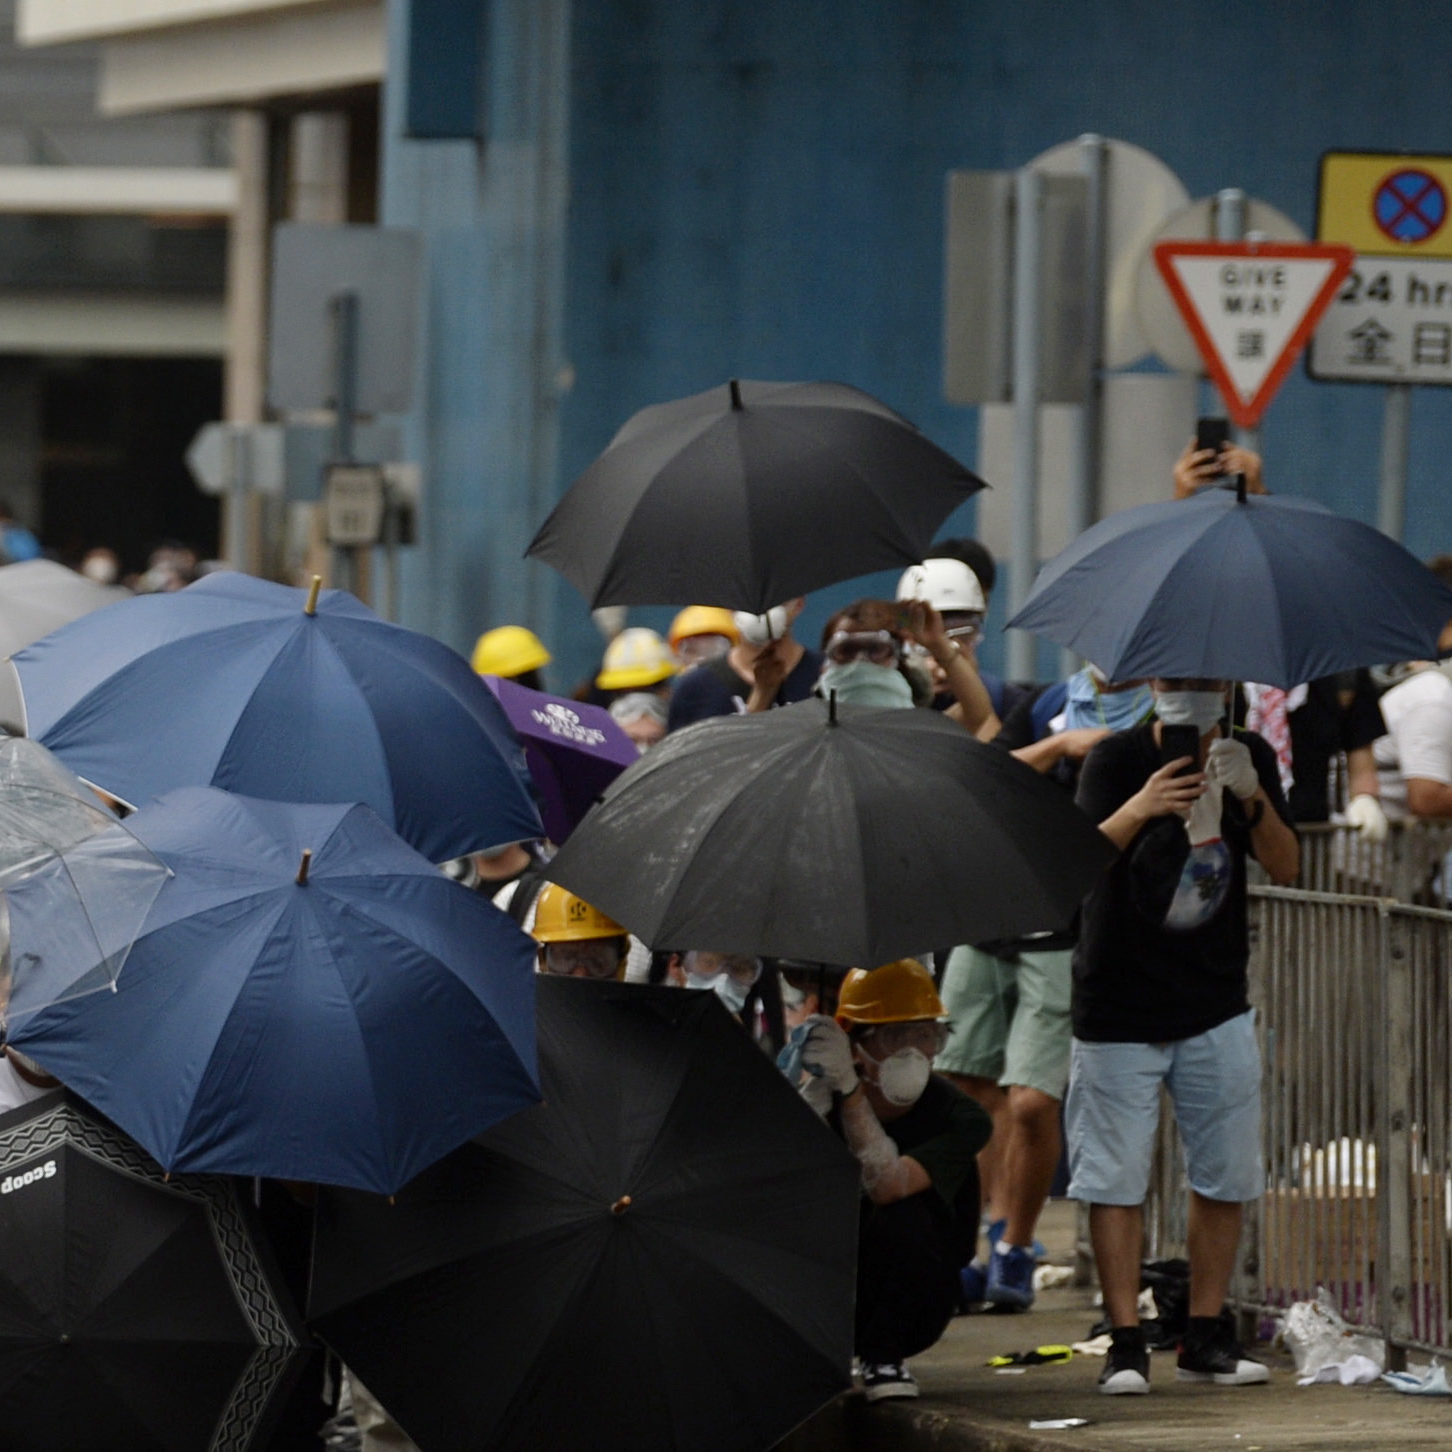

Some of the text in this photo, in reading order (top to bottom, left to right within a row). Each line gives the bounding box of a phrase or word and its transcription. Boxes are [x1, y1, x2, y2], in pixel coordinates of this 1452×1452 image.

[1220, 264, 1287, 287] GIVE
[1338, 268, 1452, 307] 24 hr
[1223, 295, 1286, 316] WAY
[1346, 317, 1451, 367] 全日
[0, 1160, 58, 1195] Scoop
